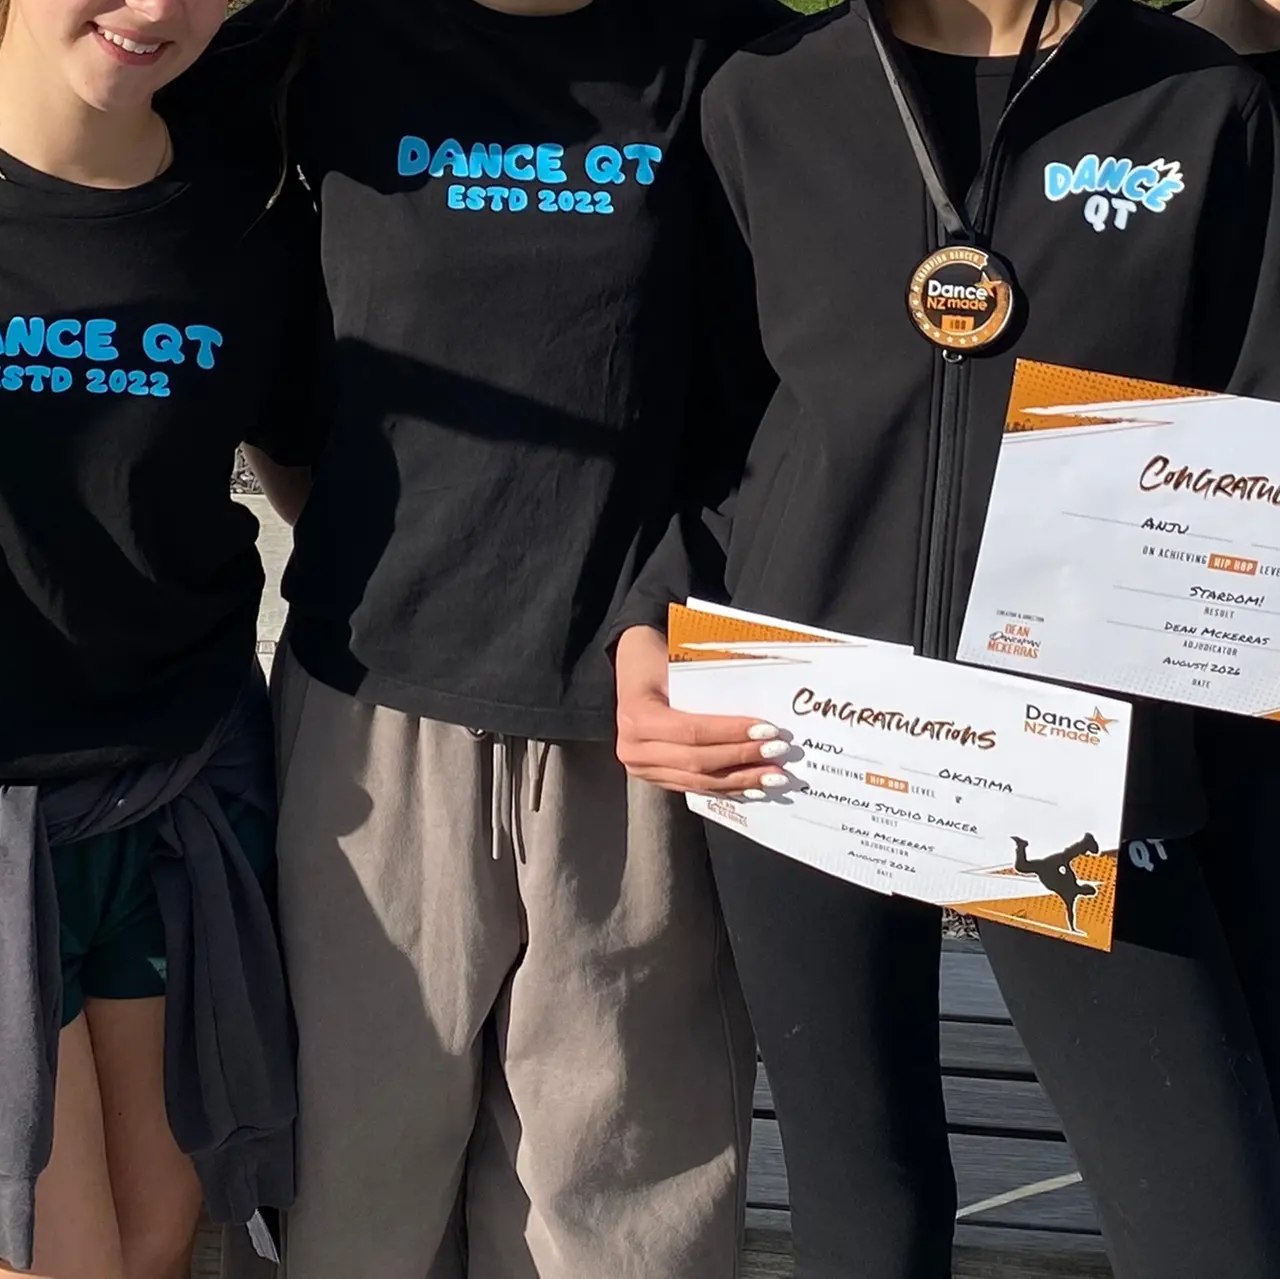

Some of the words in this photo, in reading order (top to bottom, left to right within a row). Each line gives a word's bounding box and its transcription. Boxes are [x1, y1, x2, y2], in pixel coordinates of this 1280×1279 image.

[397, 135, 568, 185] DANCE
[584, 142, 663, 185] QT
[1044, 154, 1185, 213] DANCE
[446, 184, 529, 212] ESTD
[536, 188, 615, 215] 2022
[1083, 194, 1138, 232] QT
[926, 296, 947, 310] NZ
[946, 297, 989, 311] made
[927, 279, 988, 301] Dance
[142, 322, 223, 370] QT
[85, 368, 171, 398] 2022
[1140, 516, 1190, 535] ANJU
[1142, 545, 1155, 556] ON
[1157, 548, 1208, 565] ACHIEVING
[1212, 557, 1231, 569] HIP
[1233, 560, 1254, 572] HOP
[1188, 585, 1266, 608] STARDOM!
[1203, 606, 1235, 620] RESULT
[1163, 621, 1198, 635] DEAN
[1182, 639, 1239, 657] ADJUDICATOR
[1191, 677, 1212, 690] DATE
[1023, 720, 1048, 737] NZ
[1049, 726, 1101, 746] made
[1025, 703, 1102, 735] Dance
[801, 737, 844, 755] ANJU
[938, 768, 1014, 794] OKAJIMA
[820, 764, 865, 782] ACHIEVING
[910, 785, 937, 799] LEVEL
[799, 786, 870, 809] CHAMPION
[874, 802, 922, 821] STUDIO
[926, 814, 979, 835] DANCER
[840, 823, 870, 838] DEAN
[1128, 838, 1168, 872] QT
